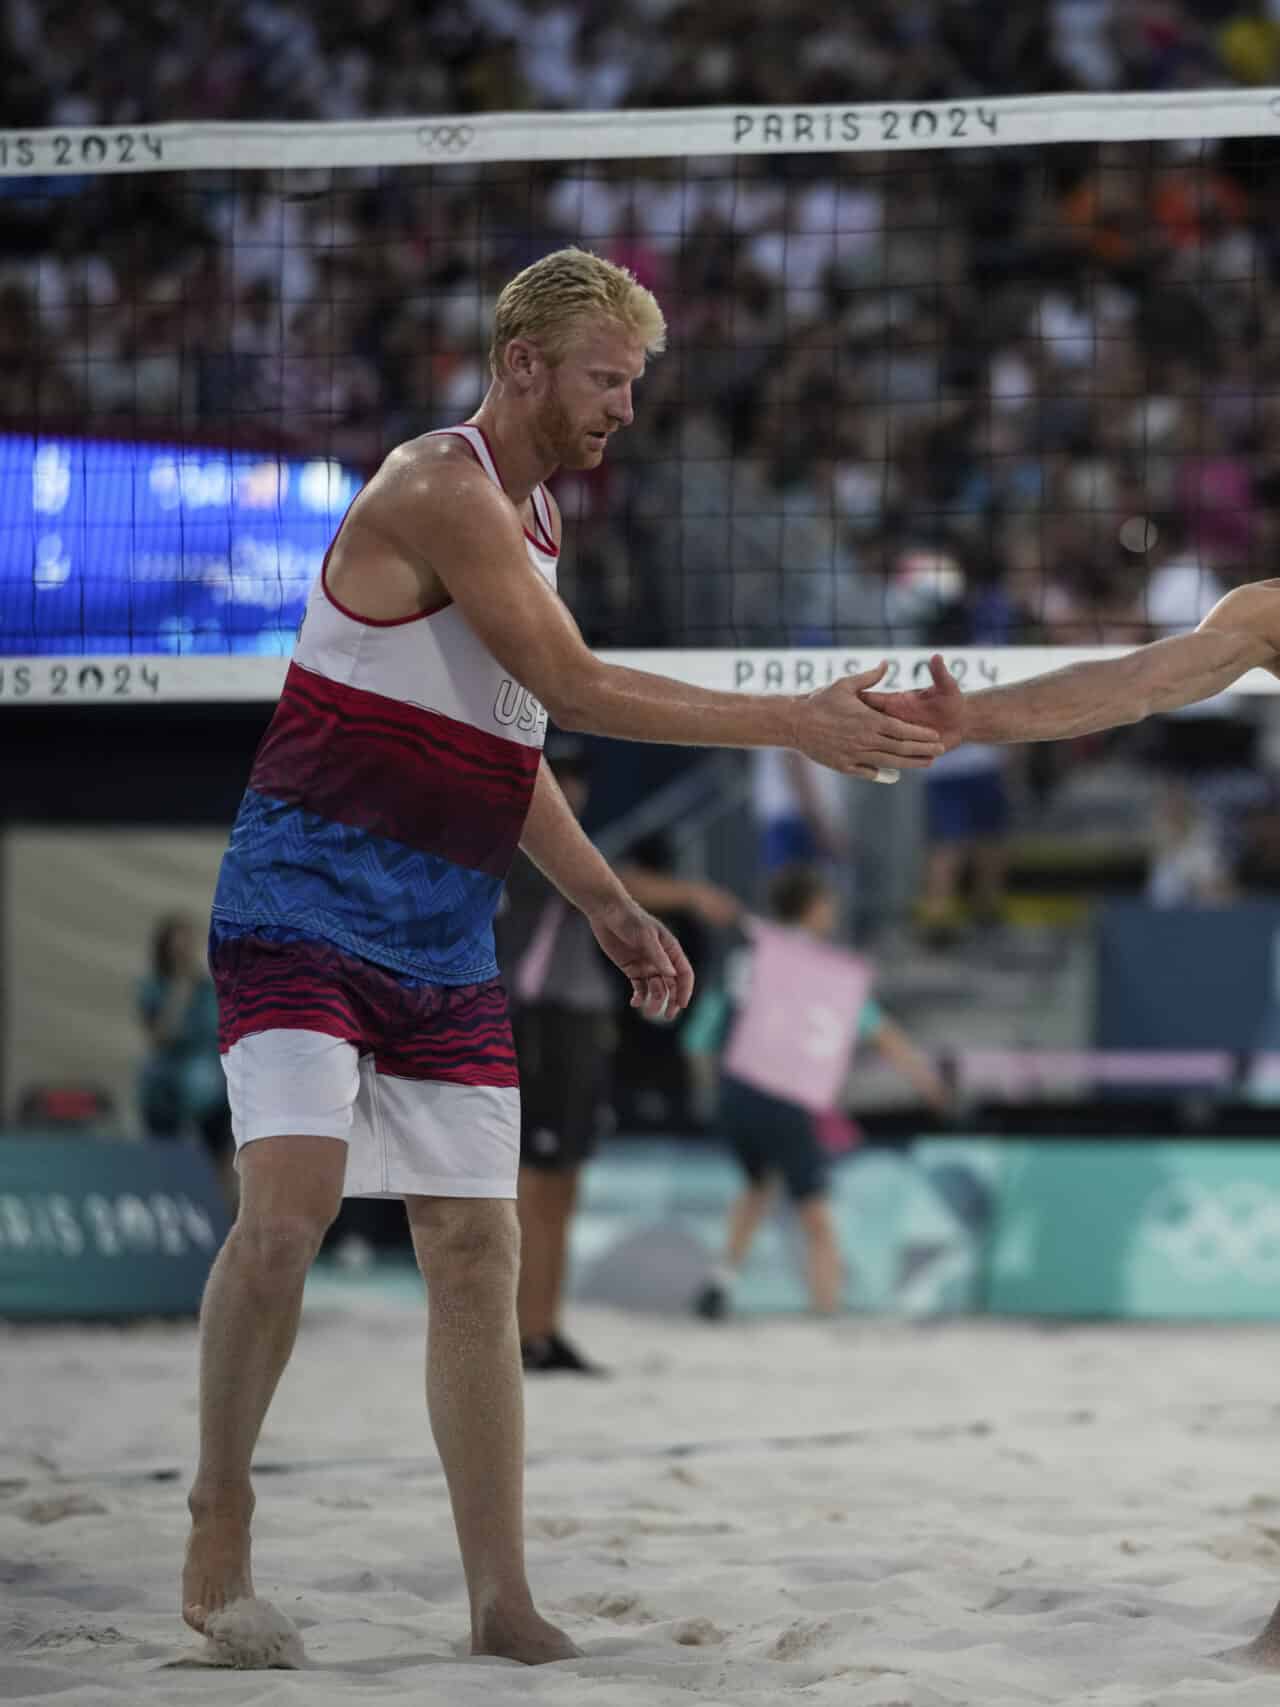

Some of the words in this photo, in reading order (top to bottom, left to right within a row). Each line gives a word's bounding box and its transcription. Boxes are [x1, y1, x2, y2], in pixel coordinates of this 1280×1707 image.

[881, 106, 998, 141] 2024
[52, 133, 163, 166] 2024
[50, 663, 160, 696] 2024
